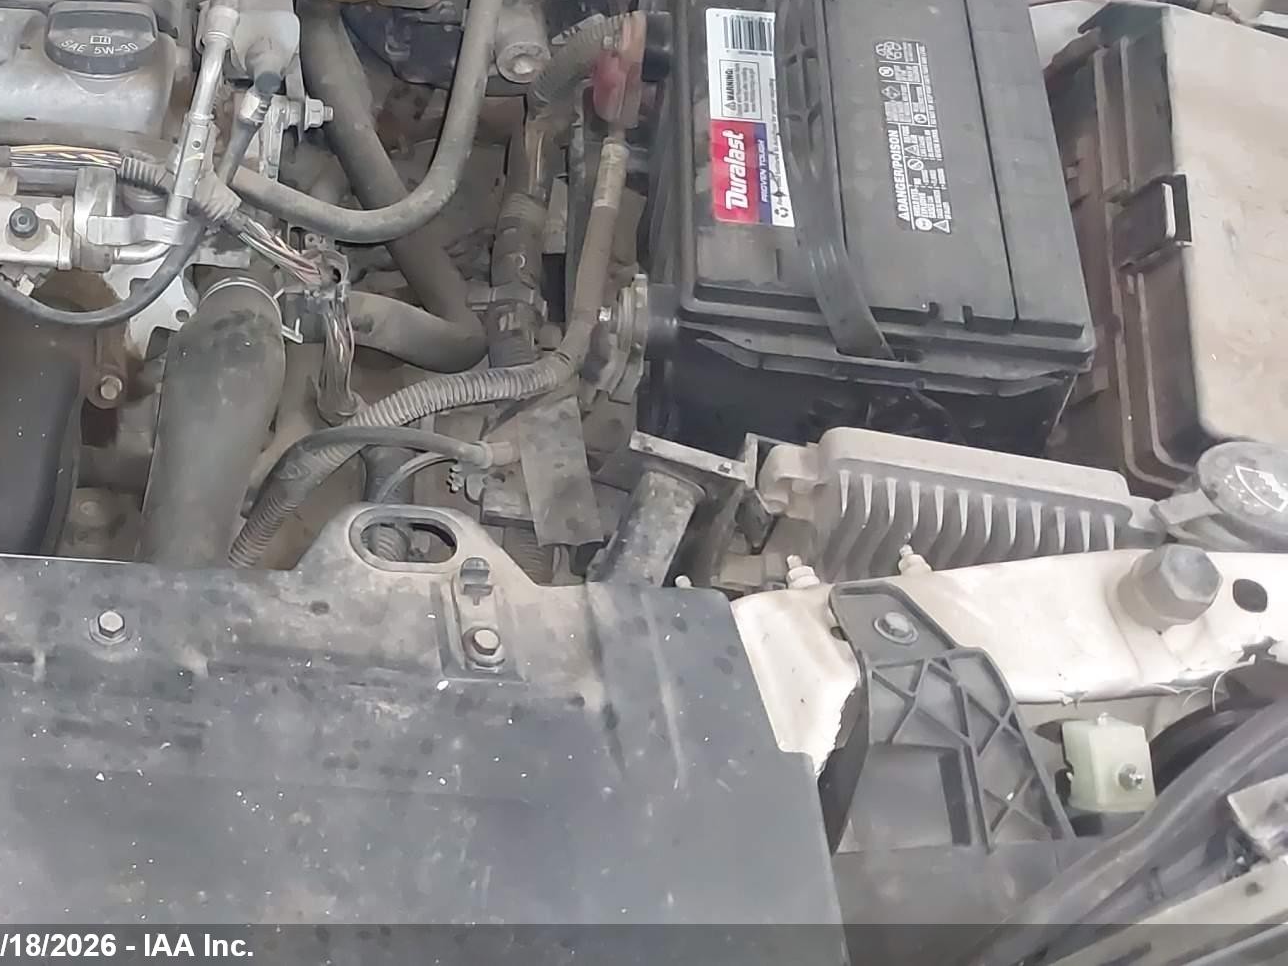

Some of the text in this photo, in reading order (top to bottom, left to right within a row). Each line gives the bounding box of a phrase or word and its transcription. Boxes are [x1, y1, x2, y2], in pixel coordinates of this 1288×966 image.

[60, 38, 139, 55] SAE 5W-30
[720, 129, 749, 210] Duralast
[757, 139, 769, 203] PROVEN TOUGH
[887, 129, 909, 212] DANGER/POISON
